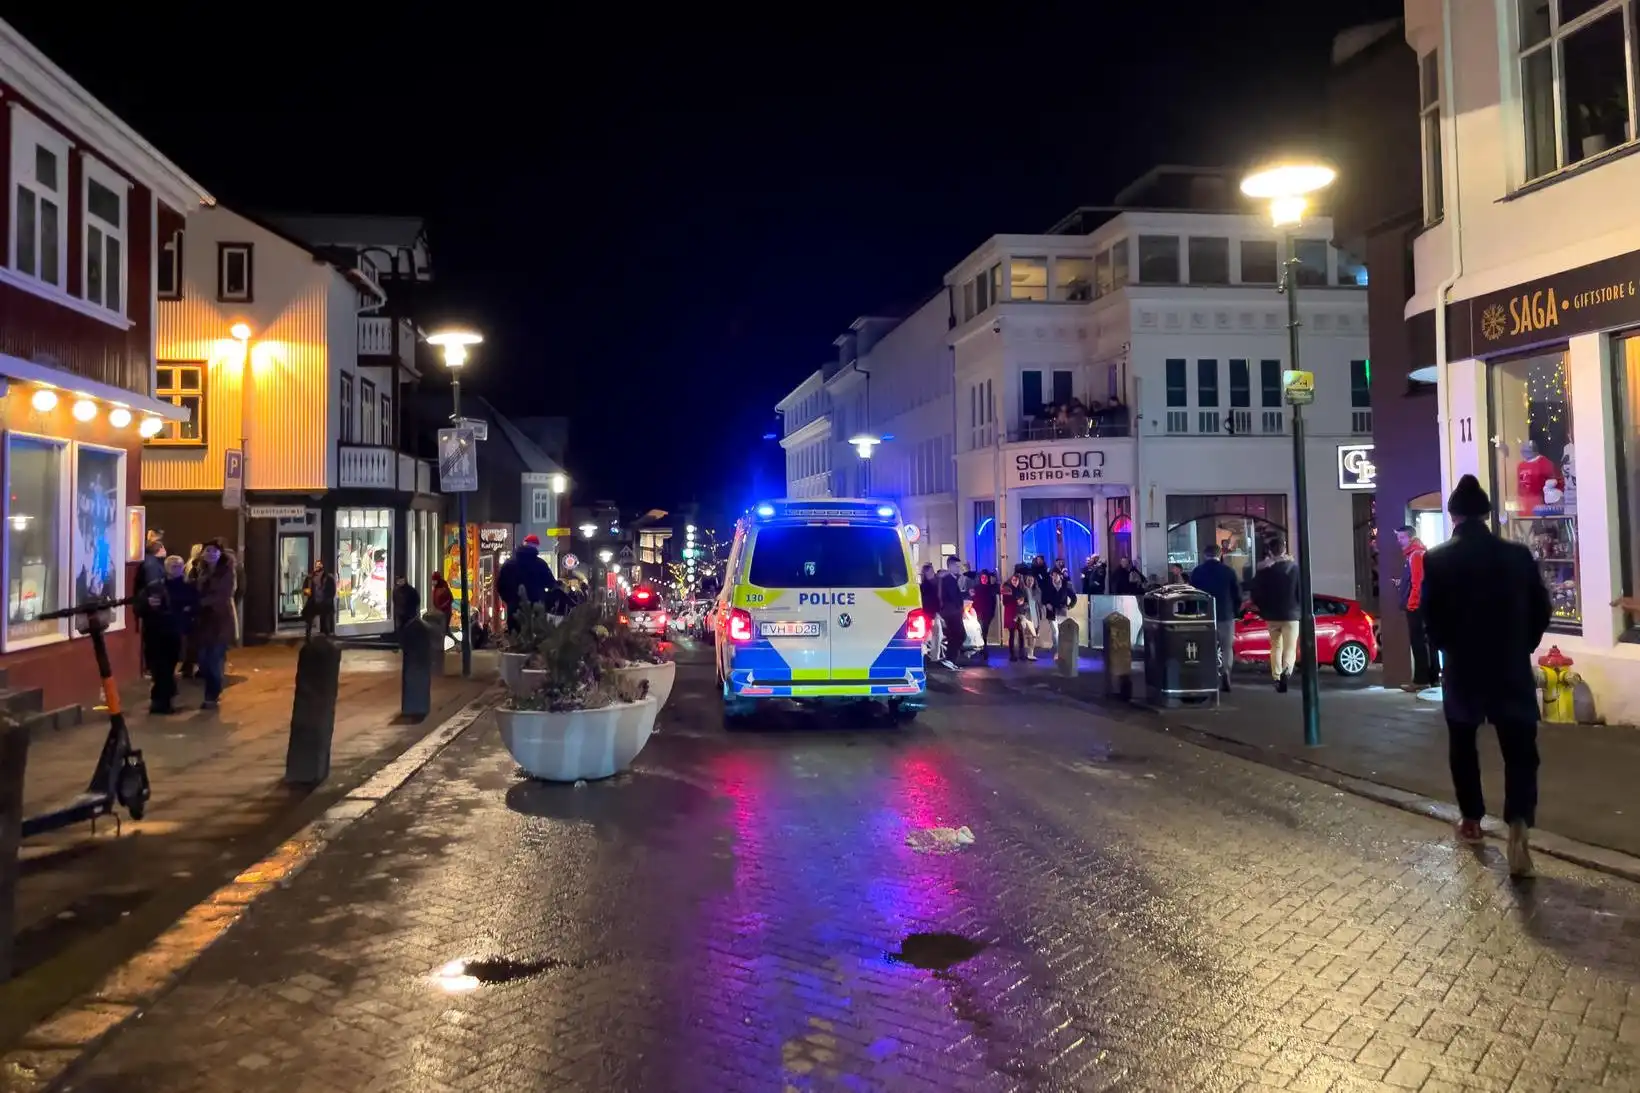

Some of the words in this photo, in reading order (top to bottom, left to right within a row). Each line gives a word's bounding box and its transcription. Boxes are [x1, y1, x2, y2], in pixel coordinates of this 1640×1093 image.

[1509, 287, 1559, 336] SAGA
[1573, 283, 1625, 309] GIFTSTORE
[1459, 417, 1473, 443] 11
[230, 457, 239, 474] P
[745, 594, 764, 603] 130
[799, 592, 856, 605] POLICE
[769, 624, 786, 635] VH
[795, 624, 817, 635] D28
